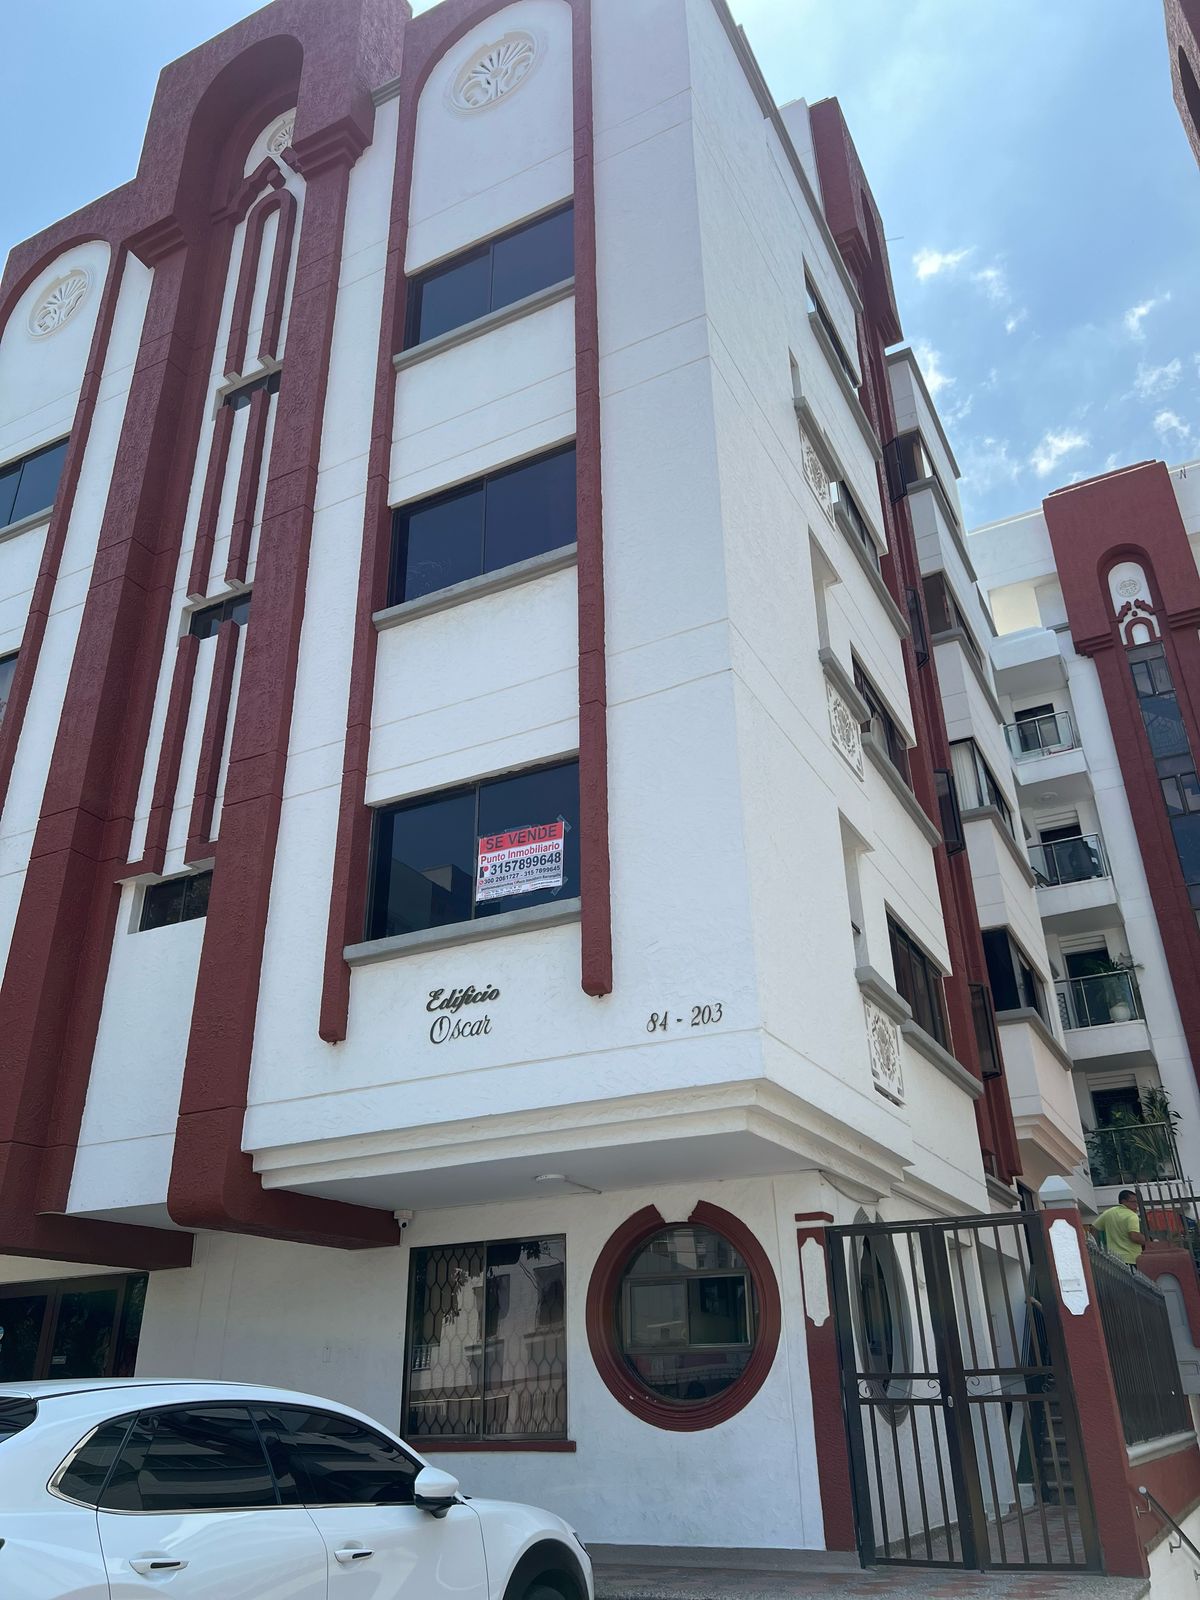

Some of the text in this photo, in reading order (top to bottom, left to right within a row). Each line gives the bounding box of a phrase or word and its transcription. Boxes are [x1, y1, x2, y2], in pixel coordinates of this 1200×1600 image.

[486, 825, 558, 850] SE VENDE
[480, 842, 561, 864] Punto Inmobiliario
[490, 852, 561, 875] 3157899648
[426, 983, 501, 1014] Edificio
[429, 1014, 493, 1045] Oscar
[646, 1010, 669, 1033] 84
[691, 1002, 723, 1027] 203
